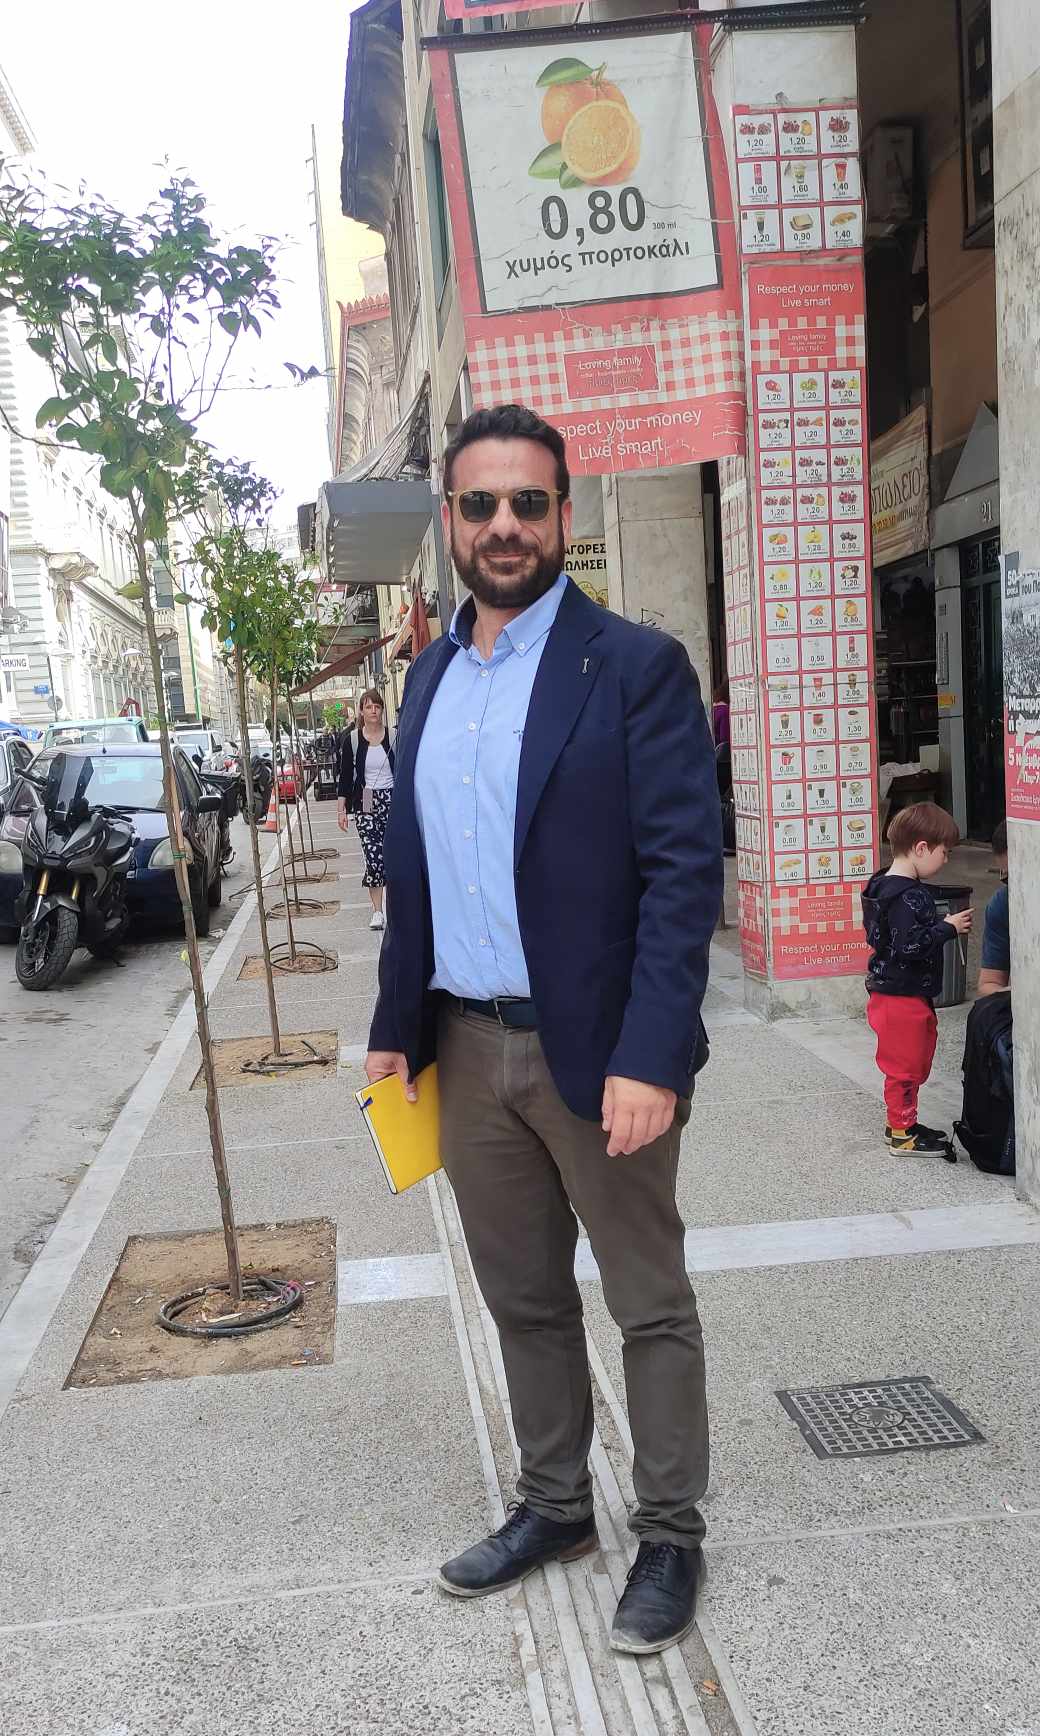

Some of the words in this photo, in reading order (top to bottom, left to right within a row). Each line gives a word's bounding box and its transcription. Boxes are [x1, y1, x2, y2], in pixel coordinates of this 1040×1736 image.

[747, 140, 763, 148] 1,20
[790, 137, 806, 145] 1,20
[831, 135, 847, 143] 1,20
[751, 186, 767, 195] 1,00
[792, 185, 808, 194] 1,60
[833, 183, 848, 192] 1,40
[541, 187, 646, 246] 0,80
[754, 234, 770, 243] 1,20
[794, 233, 810, 241] 0,90
[835, 230, 850, 239] 1,40
[506, 250, 572, 279] χυμός
[578, 238, 690, 268] πορτοκάλι
[757, 284, 796, 296] Respect
[799, 284, 820, 296] your
[822, 281, 854, 293] money
[782, 298, 801, 308] Live
[804, 296, 831, 307] smart
[578, 360, 610, 370] Loving
[612, 355, 642, 368] family
[559, 418, 602, 438] spect
[606, 416, 640, 437] your
[646, 408, 702, 428] money
[578, 442, 611, 461] Live
[618, 436, 664, 456] smart
[565, 544, 606, 556] ΑΓΟΡΕΣ
[565, 559, 606, 571] ΩΛΗΣΕΙ
[782, 944, 818, 956] Respect
[820, 943, 840, 953] your
[843, 941, 872, 950] money
[804, 955, 823, 965] Live
[824, 954, 850, 964] smart
